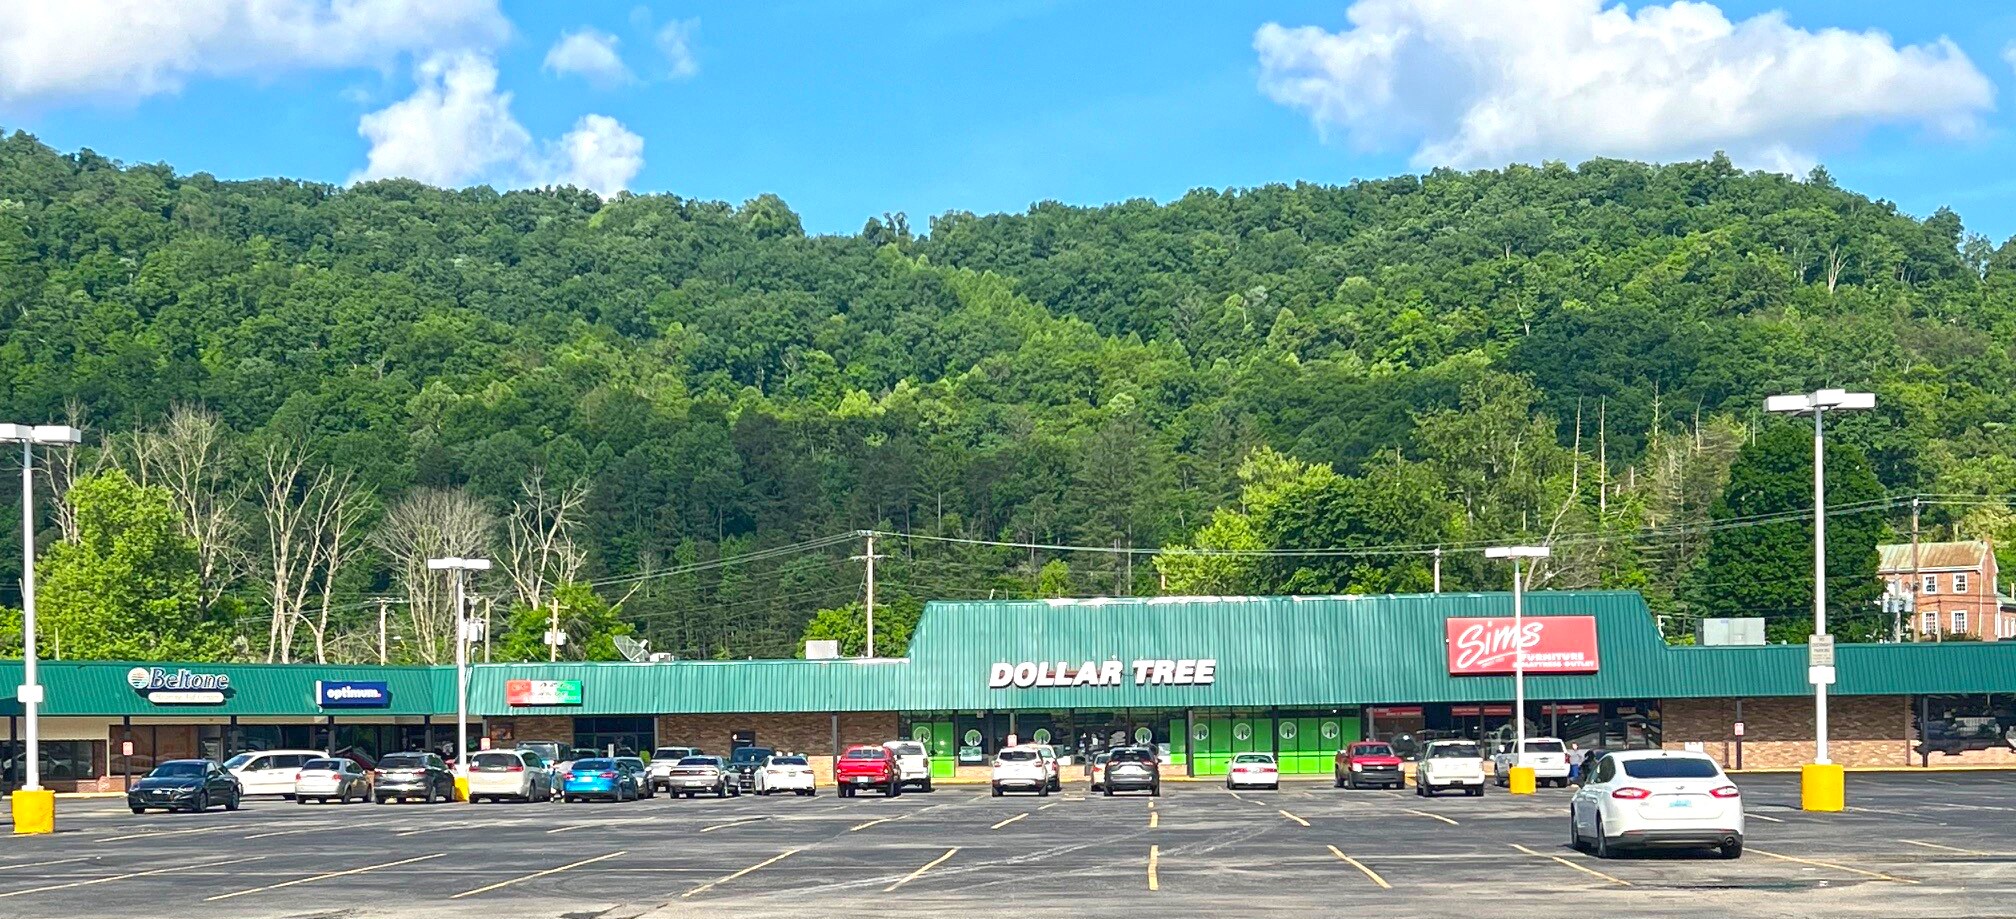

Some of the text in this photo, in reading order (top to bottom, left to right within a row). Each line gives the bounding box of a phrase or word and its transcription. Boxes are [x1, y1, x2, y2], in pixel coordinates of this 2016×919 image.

[1456, 621, 1544, 669] Sims
[1520, 652, 1584, 661] FURNITURE
[147, 667, 229, 689] Beltone
[989, 659, 1216, 688] DOLLAR TREE
